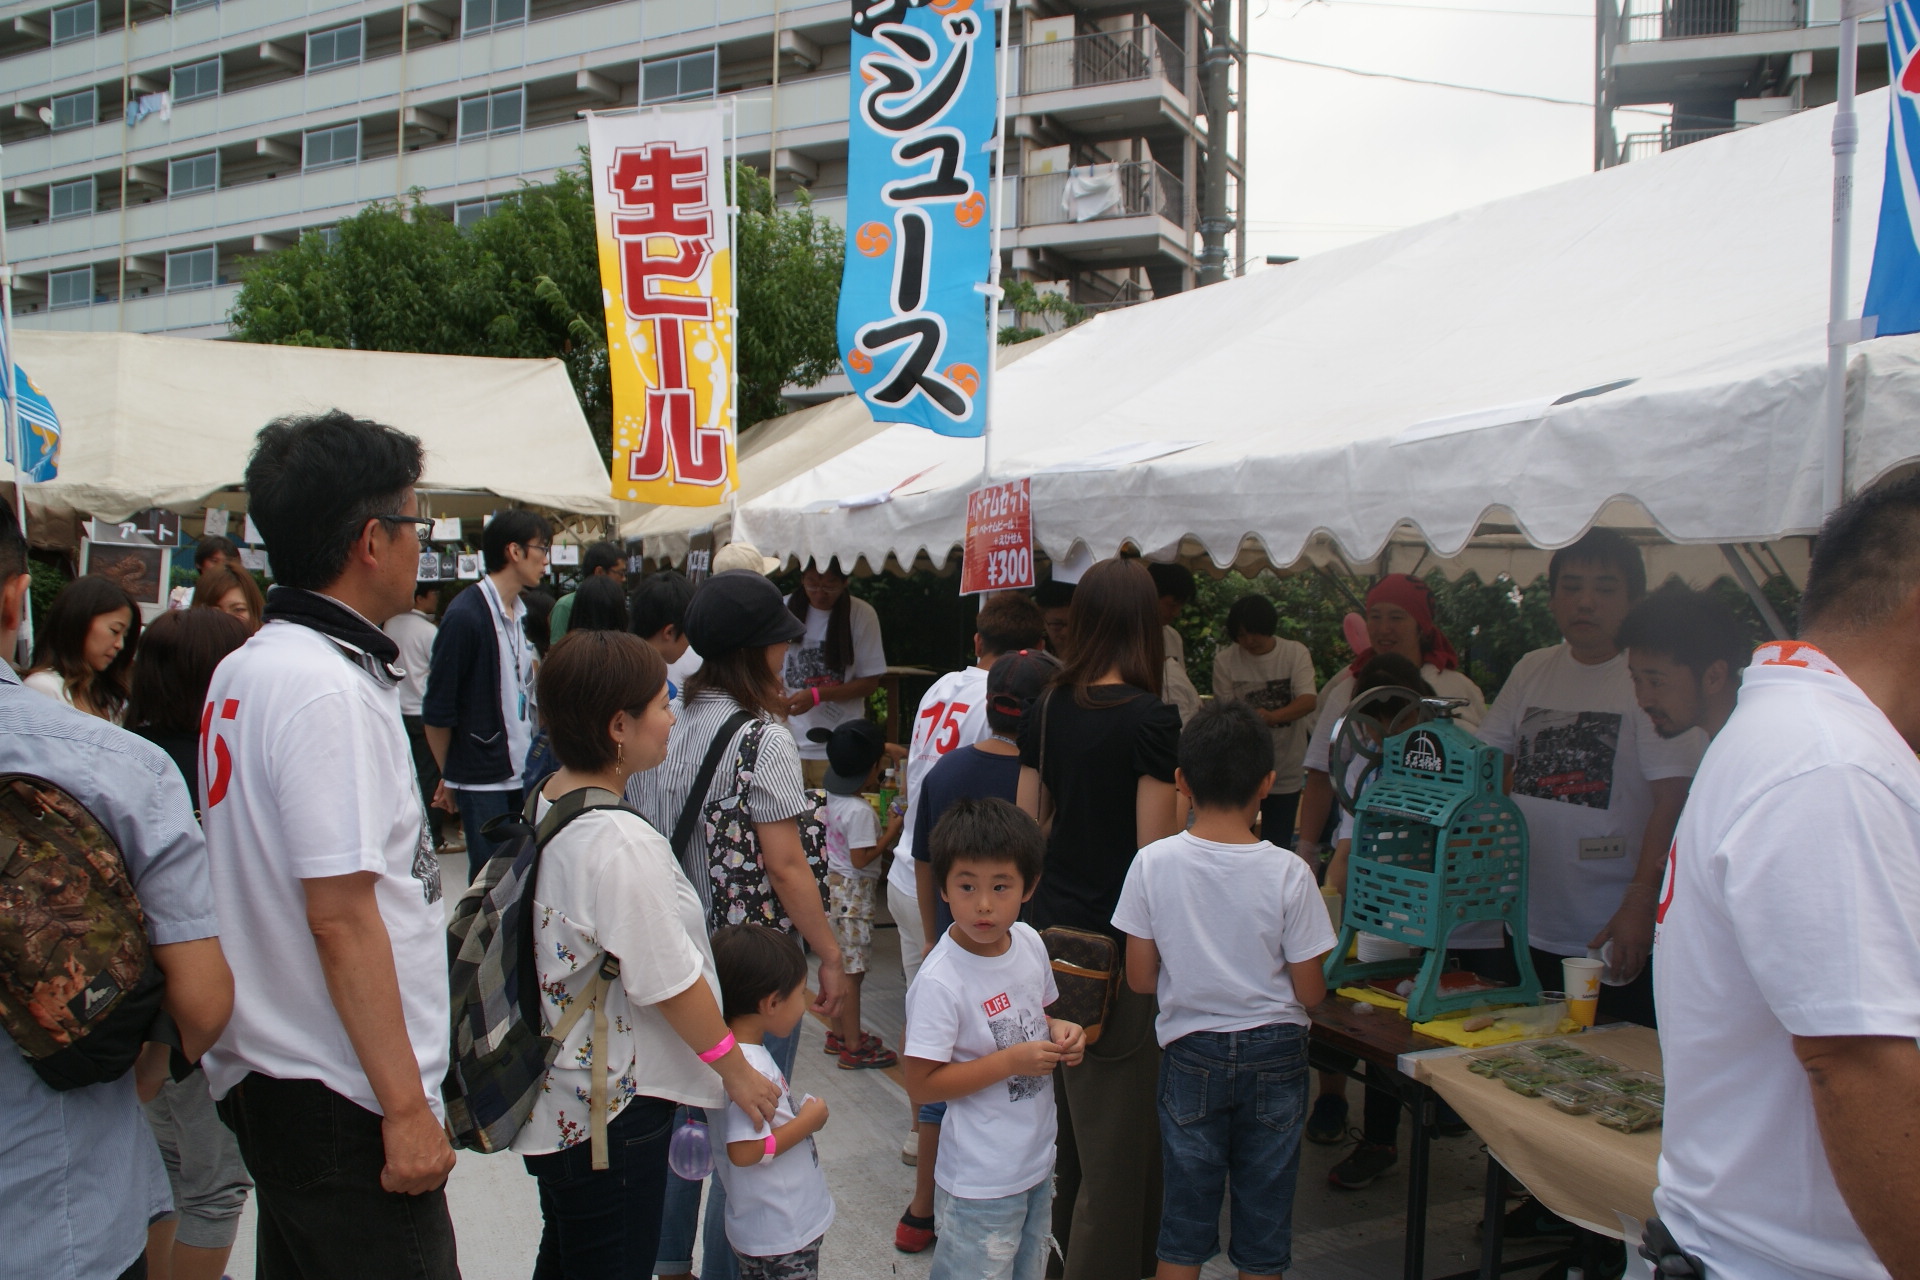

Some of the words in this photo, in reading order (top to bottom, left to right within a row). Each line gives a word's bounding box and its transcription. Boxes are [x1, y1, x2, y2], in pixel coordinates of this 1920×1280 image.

[855, 11, 982, 421] ジュース
[607, 141, 728, 487] 生ビール
[119, 522, 174, 541] アート
[988, 547, 1029, 586] ¥300
[921, 701, 970, 755] 75
[985, 993, 1010, 1016] LIFE
